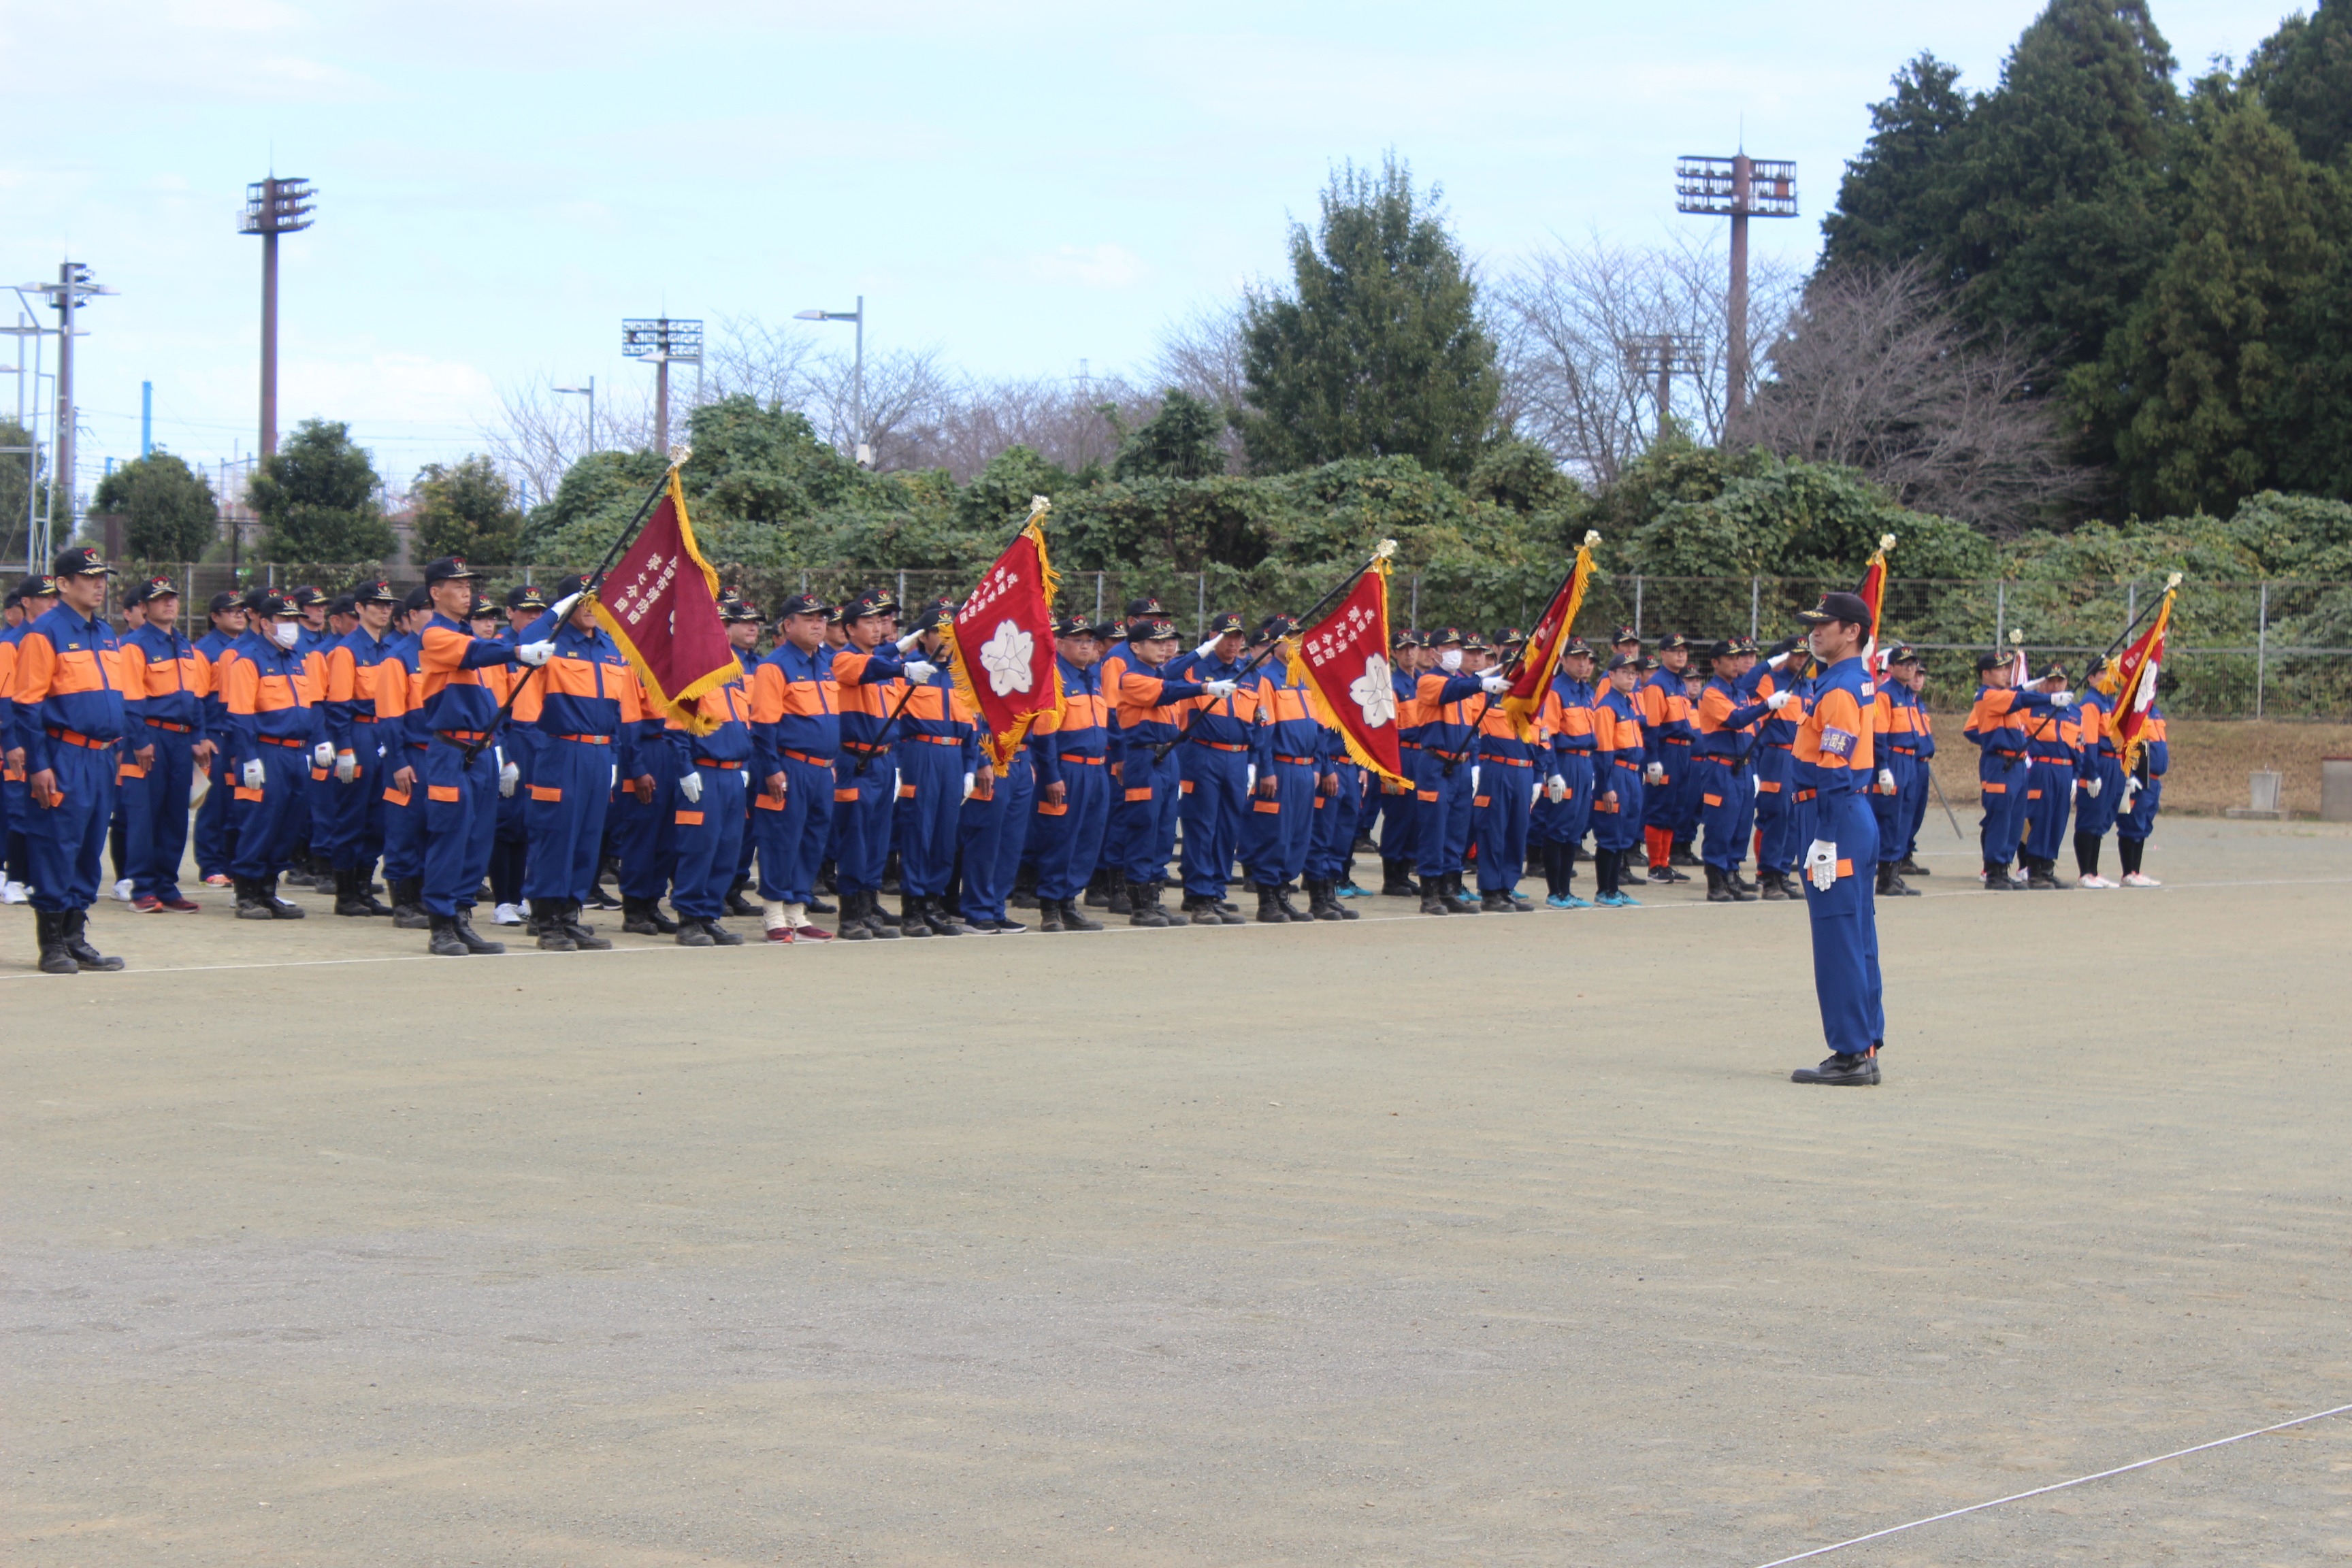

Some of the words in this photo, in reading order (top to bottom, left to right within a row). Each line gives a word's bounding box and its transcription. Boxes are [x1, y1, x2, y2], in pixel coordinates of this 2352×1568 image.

[614, 553, 663, 613] 第七分団
[1306, 605, 1360, 655] 第九分団
[1312, 608, 1375, 667] 成田市消防団
